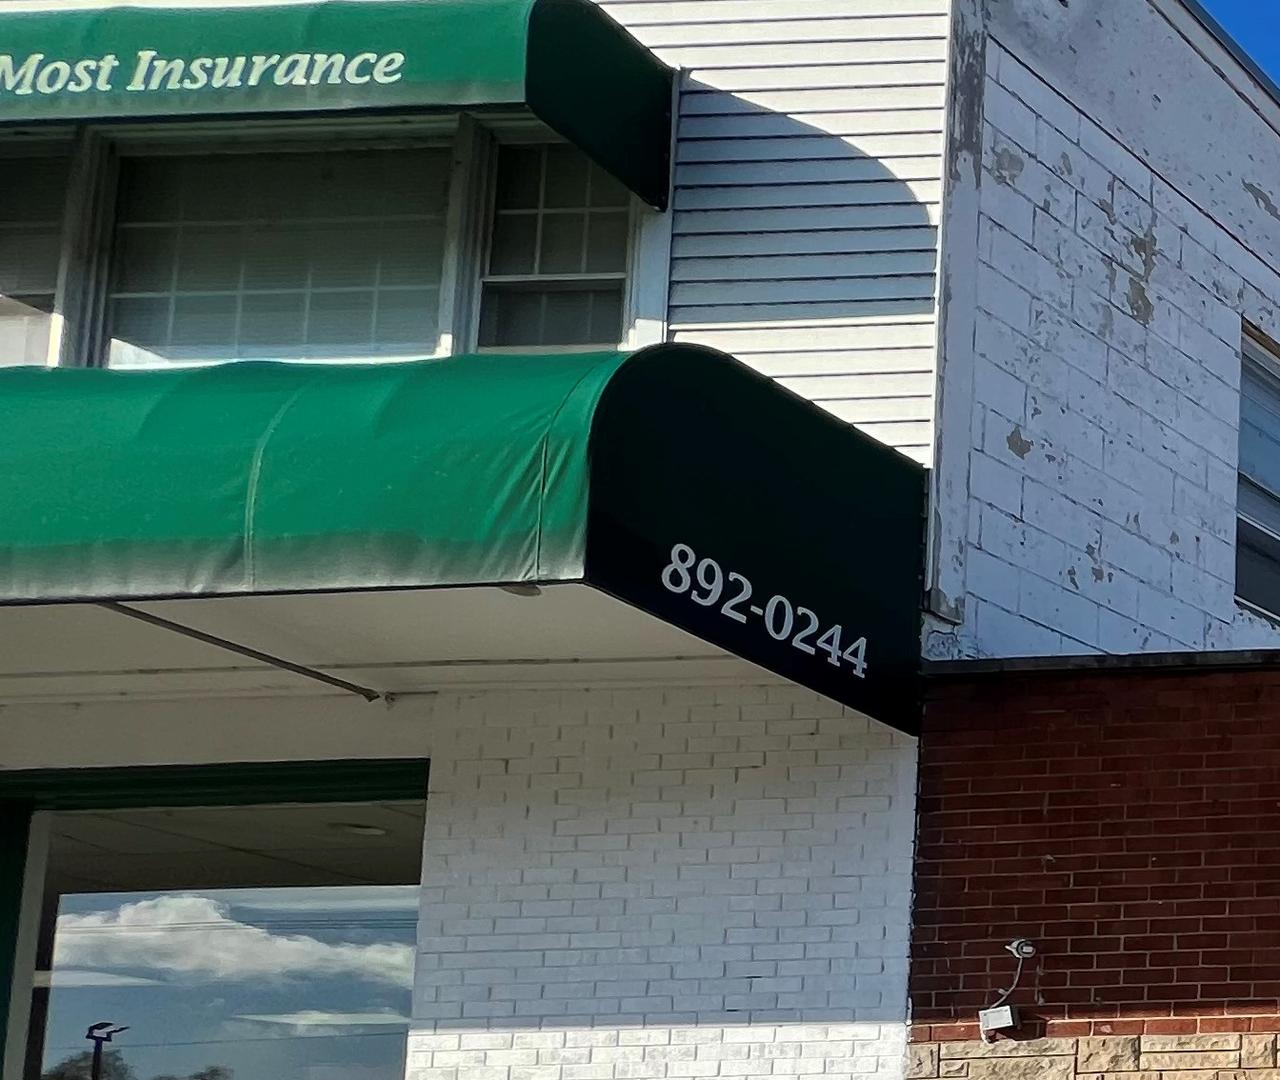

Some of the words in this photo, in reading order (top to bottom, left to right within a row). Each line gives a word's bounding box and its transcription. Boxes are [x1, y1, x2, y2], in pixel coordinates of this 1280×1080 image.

[0, 53, 119, 94] Most
[126, 49, 405, 91] Insurance
[661, 543, 868, 678] 892-0244
